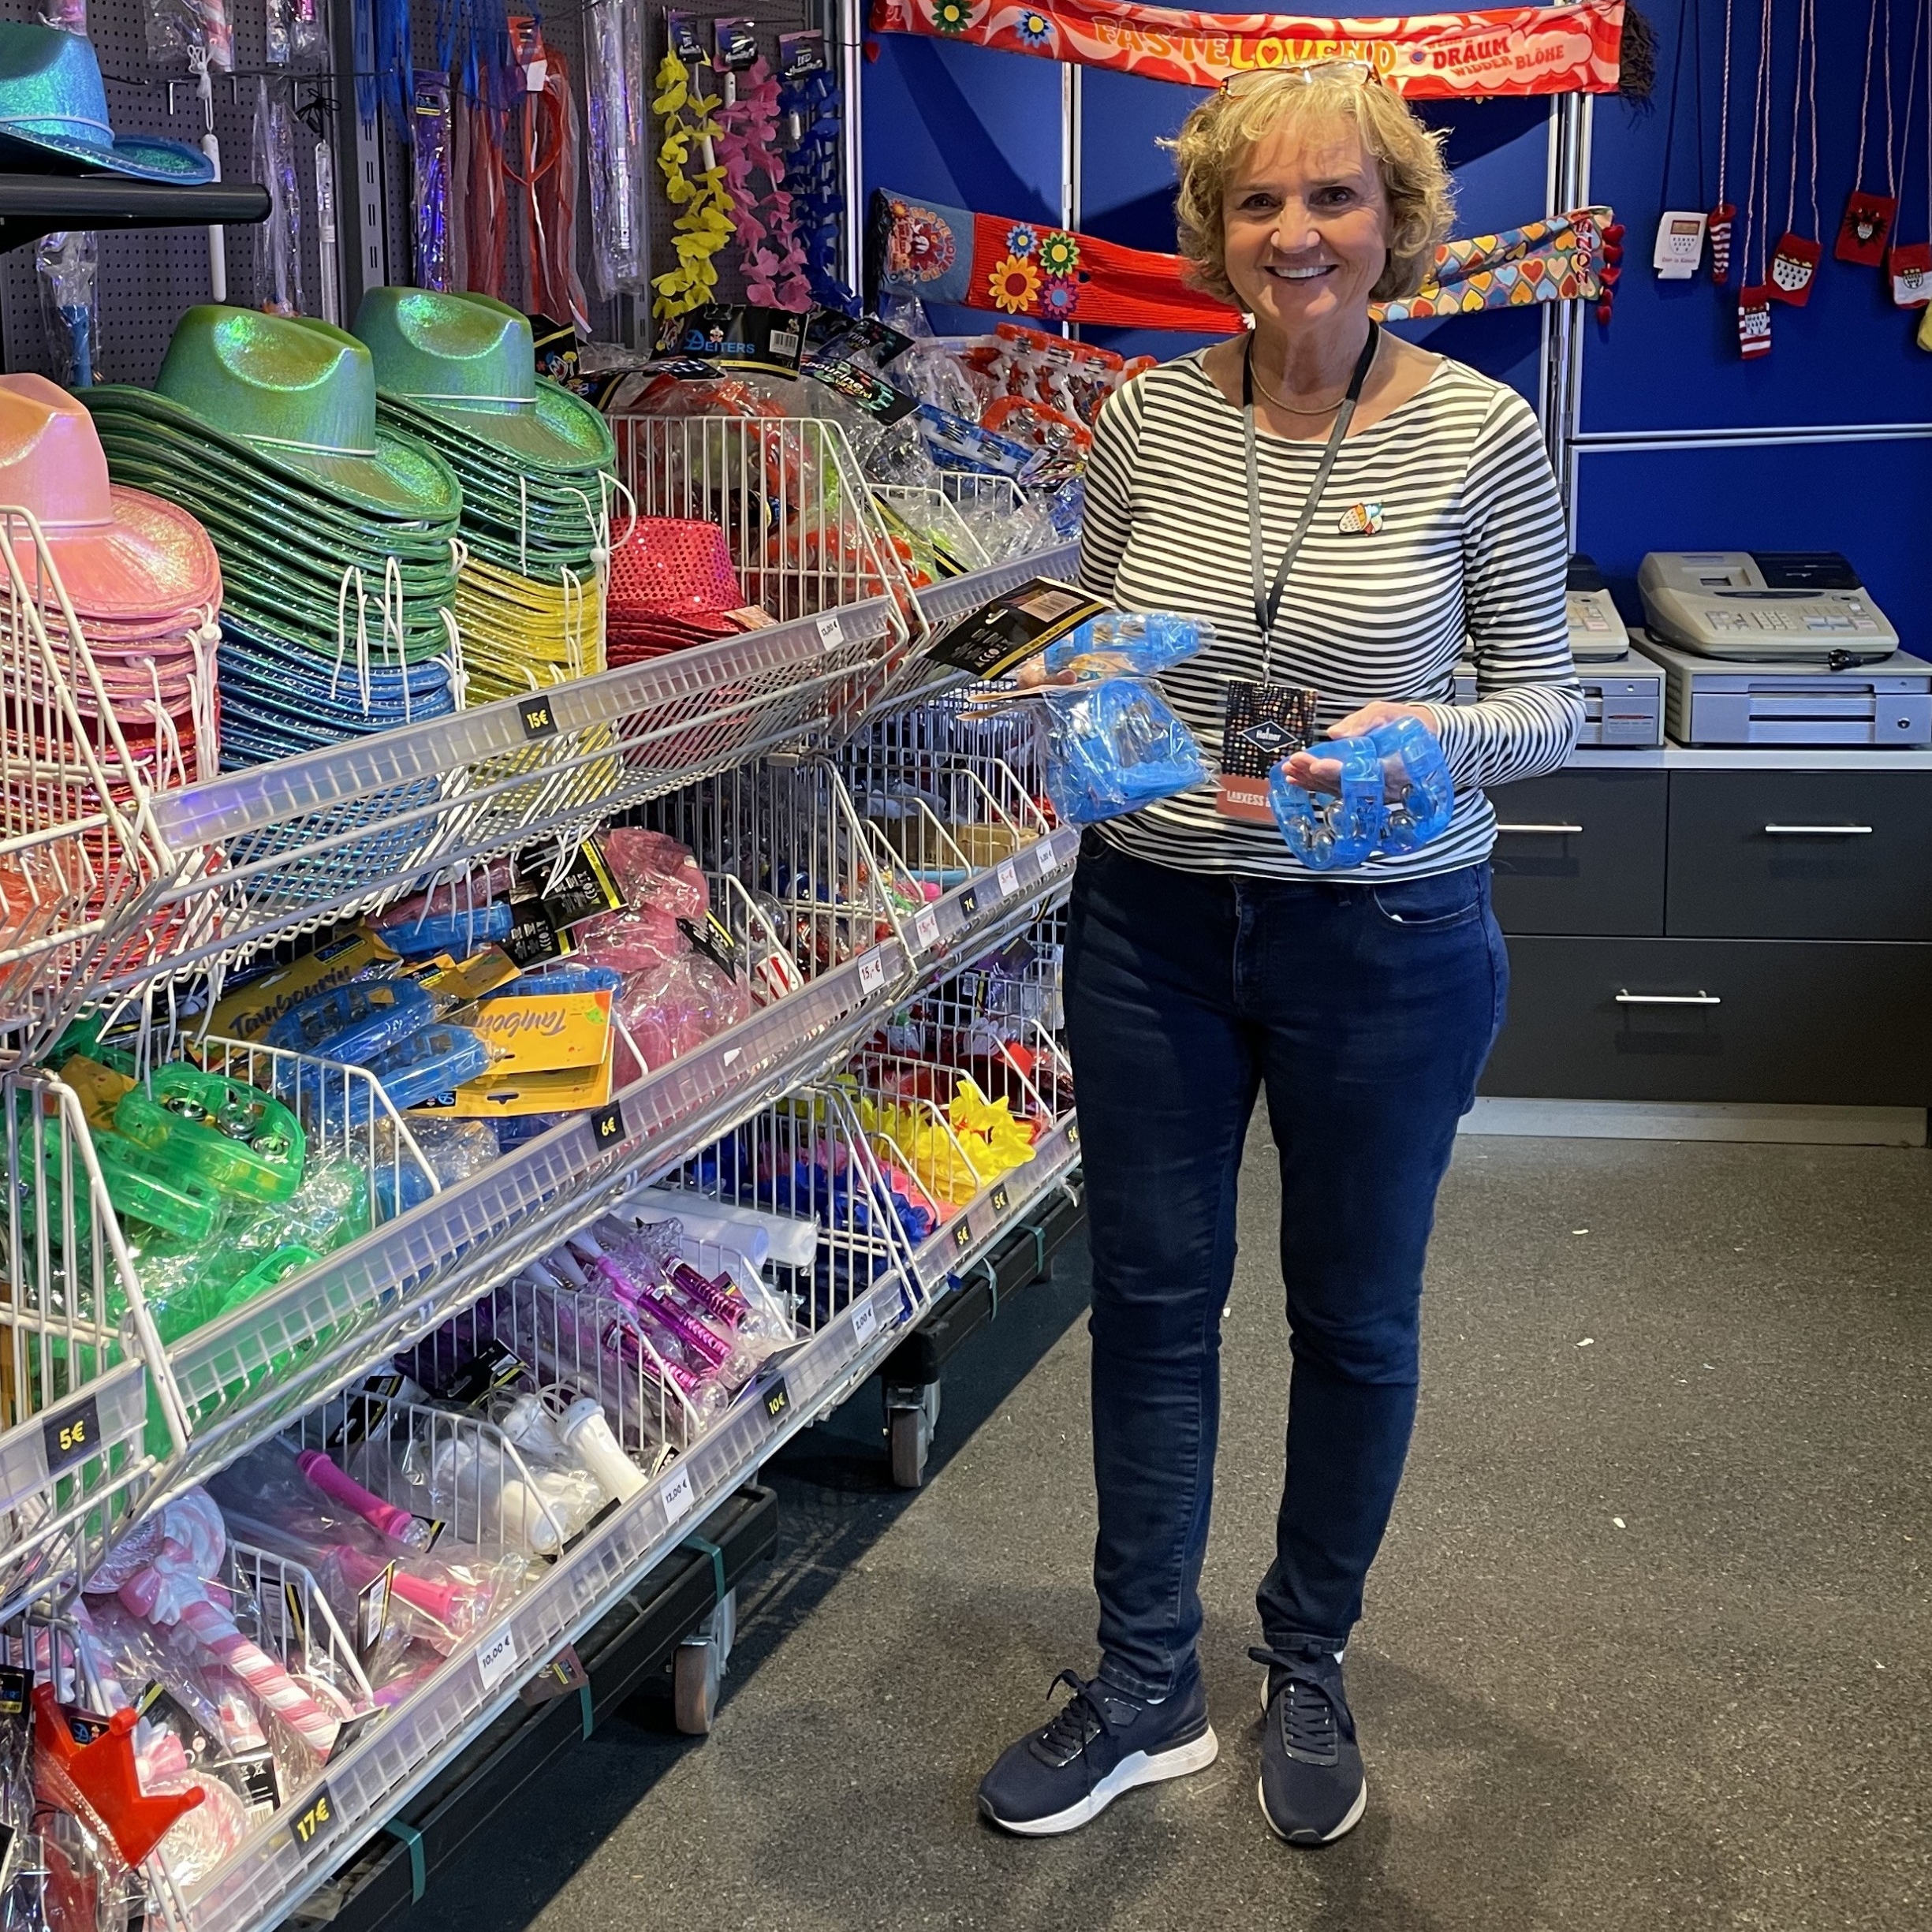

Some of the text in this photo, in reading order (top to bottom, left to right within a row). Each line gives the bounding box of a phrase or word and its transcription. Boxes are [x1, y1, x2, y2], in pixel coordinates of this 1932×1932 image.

[1091, 16, 1399, 74] FASTELOVEND
[1432, 36, 1512, 70] DRÄUM
[1449, 45, 1565, 77] WIDDER BLÖHE
[683, 328, 756, 354] DEITERS
[526, 709, 550, 729] 15€
[875, 959, 881, 973] €
[602, 1117, 617, 1136] 6€
[1068, 1125, 1079, 1143] 5€
[994, 1192, 1006, 1210] 5€
[957, 1225, 969, 1246] 5€
[768, 1392, 785, 1415] 10€
[59, 1419, 86, 1451] 5€
[665, 1478, 688, 1504] 12,00 €
[482, 1635, 510, 1669] 10,00 €
[297, 1797, 330, 1843] 17€
